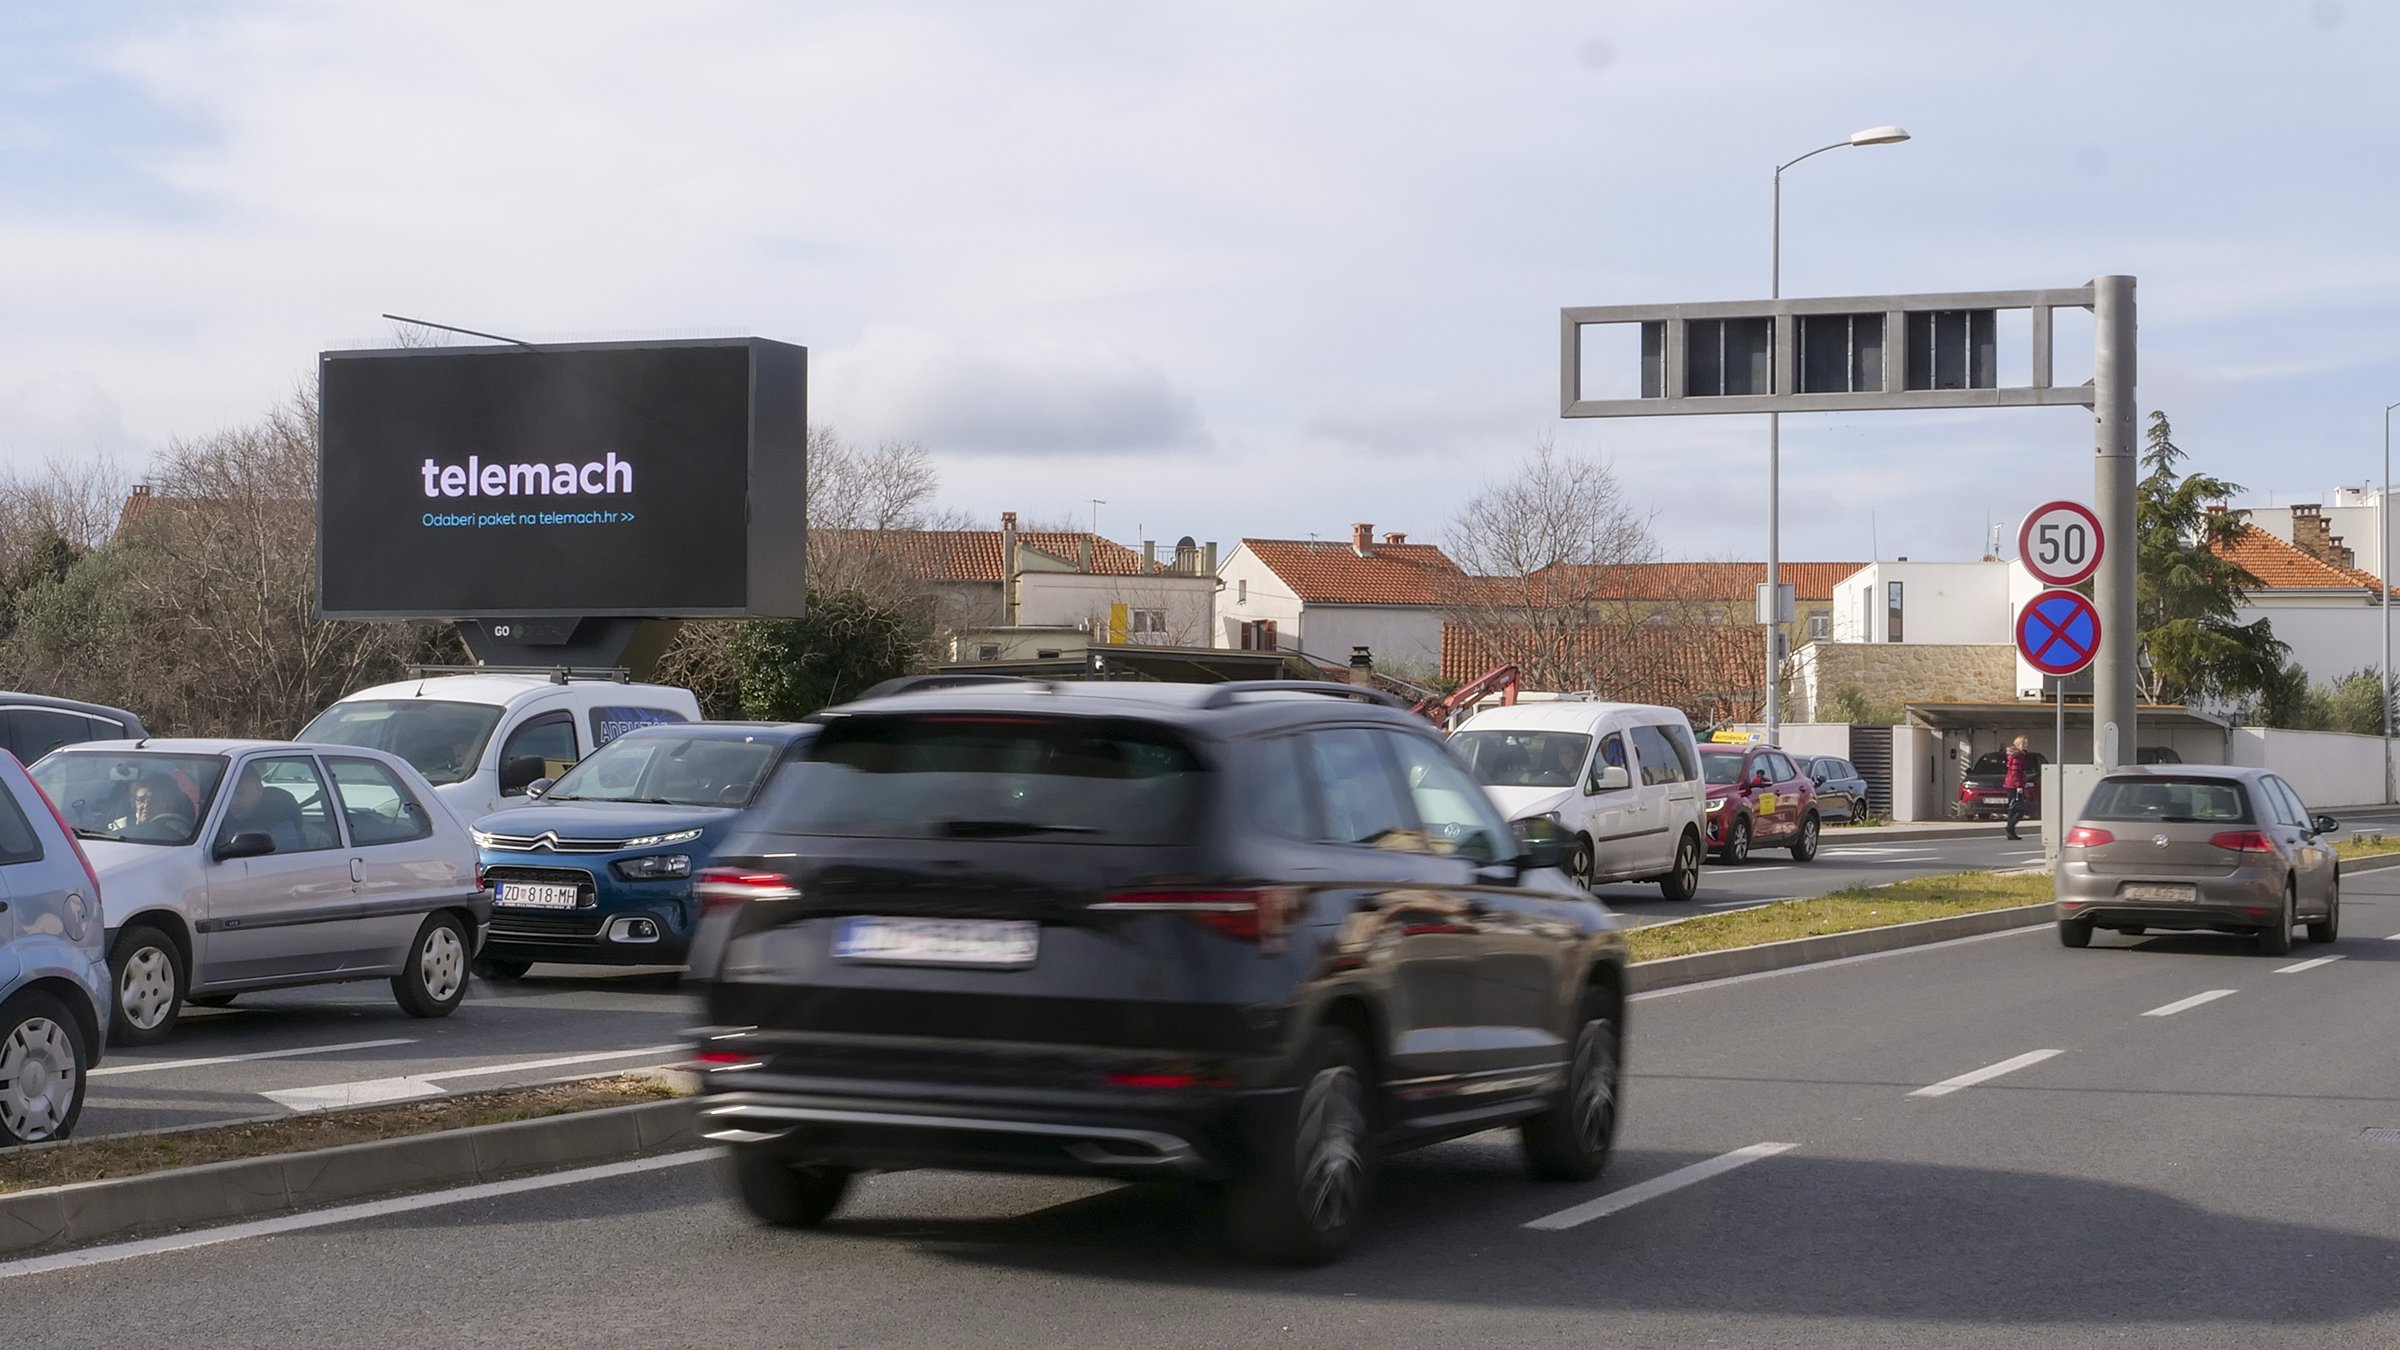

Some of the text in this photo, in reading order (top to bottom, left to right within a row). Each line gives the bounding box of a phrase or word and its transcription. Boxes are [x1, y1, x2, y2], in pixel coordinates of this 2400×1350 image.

[421, 452, 633, 497] telemach
[422, 513, 476, 527] Odaberi
[478, 513, 516, 528] paket
[519, 515, 536, 526] na
[540, 510, 617, 525] telemach.hr
[2039, 524, 2086, 564] 50
[504, 886, 519, 901] ZD
